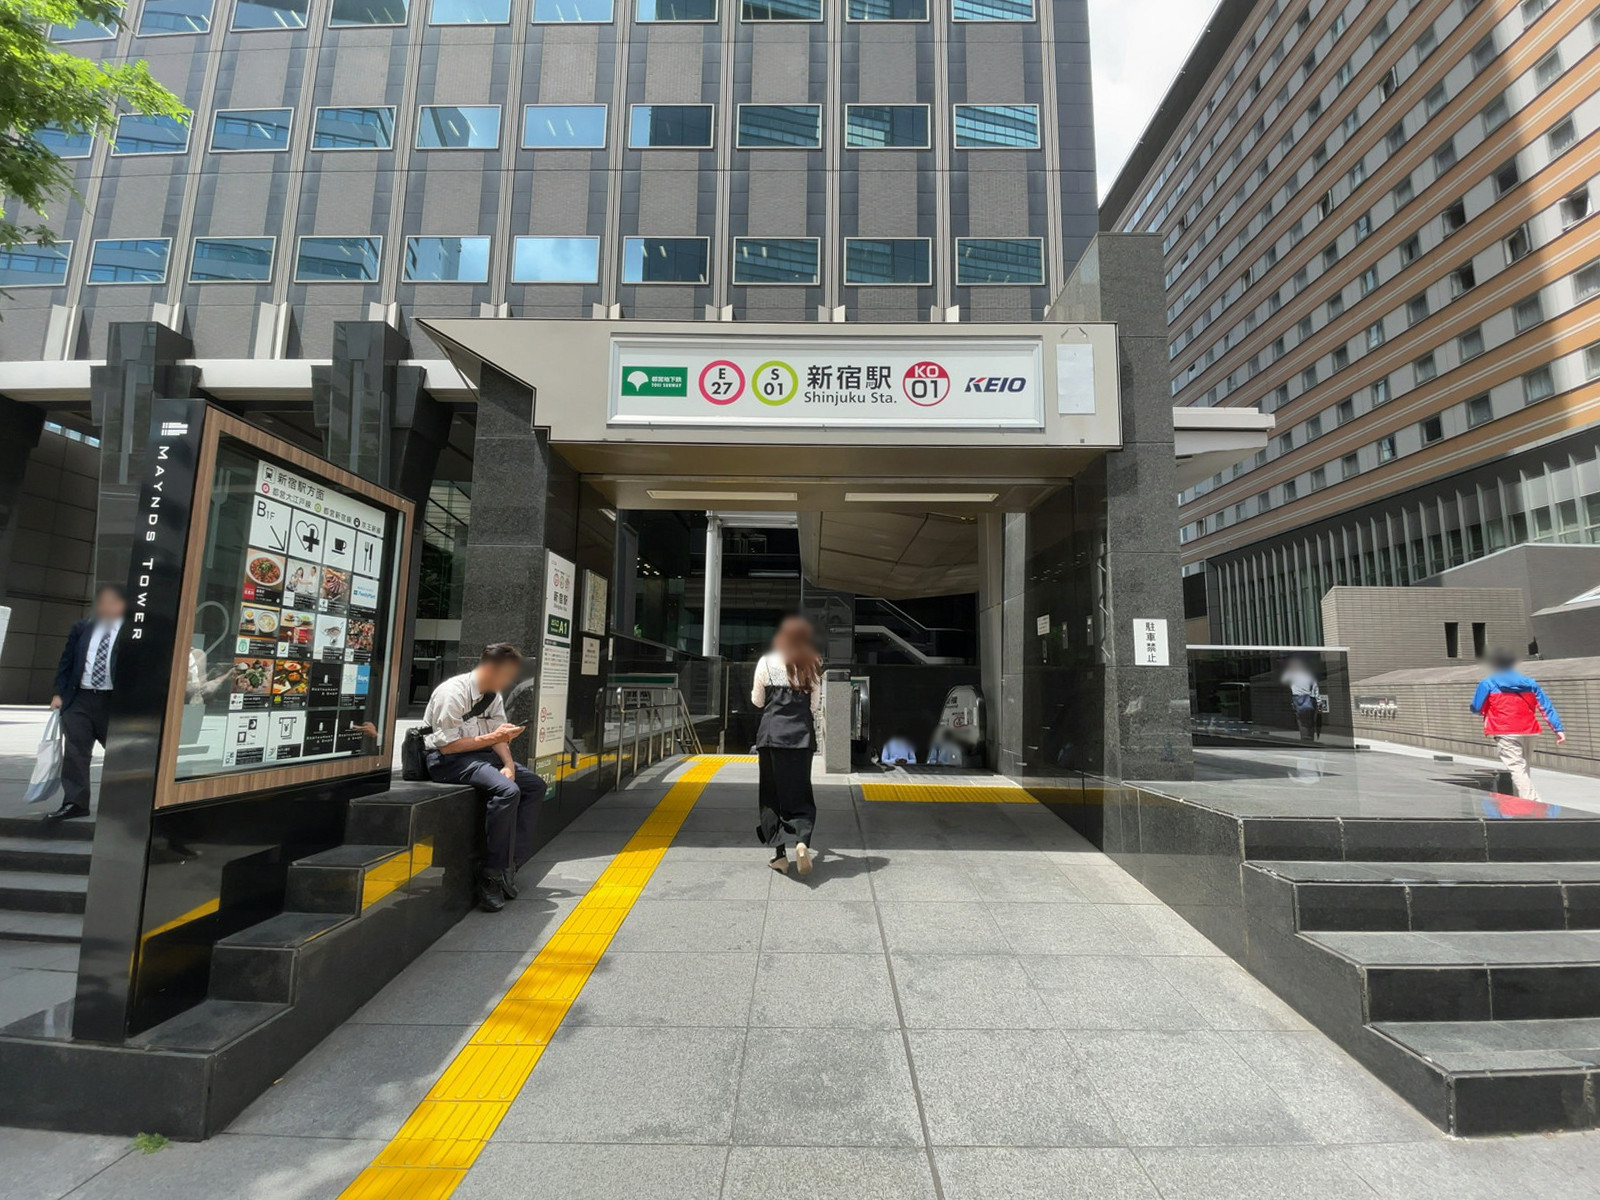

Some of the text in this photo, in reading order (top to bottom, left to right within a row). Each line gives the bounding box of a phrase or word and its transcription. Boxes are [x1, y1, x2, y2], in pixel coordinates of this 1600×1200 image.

[718, 368, 726, 380] E
[770, 368, 780, 381] S
[806, 365, 892, 390] 新宿駅
[914, 365, 940, 378] KO
[711, 382, 733, 395] 27
[763, 383, 784, 396] 01
[911, 379, 938, 399] 01
[964, 377, 1027, 393] KEIO
[804, 391, 897, 406] Shinjuku Sta.
[277, 472, 325, 501] 新宿駅方面
[131, 446, 170, 640] MAYNDS TOWER
[558, 621, 568, 635] A1
[1144, 621, 1158, 664] 駐車禁止
